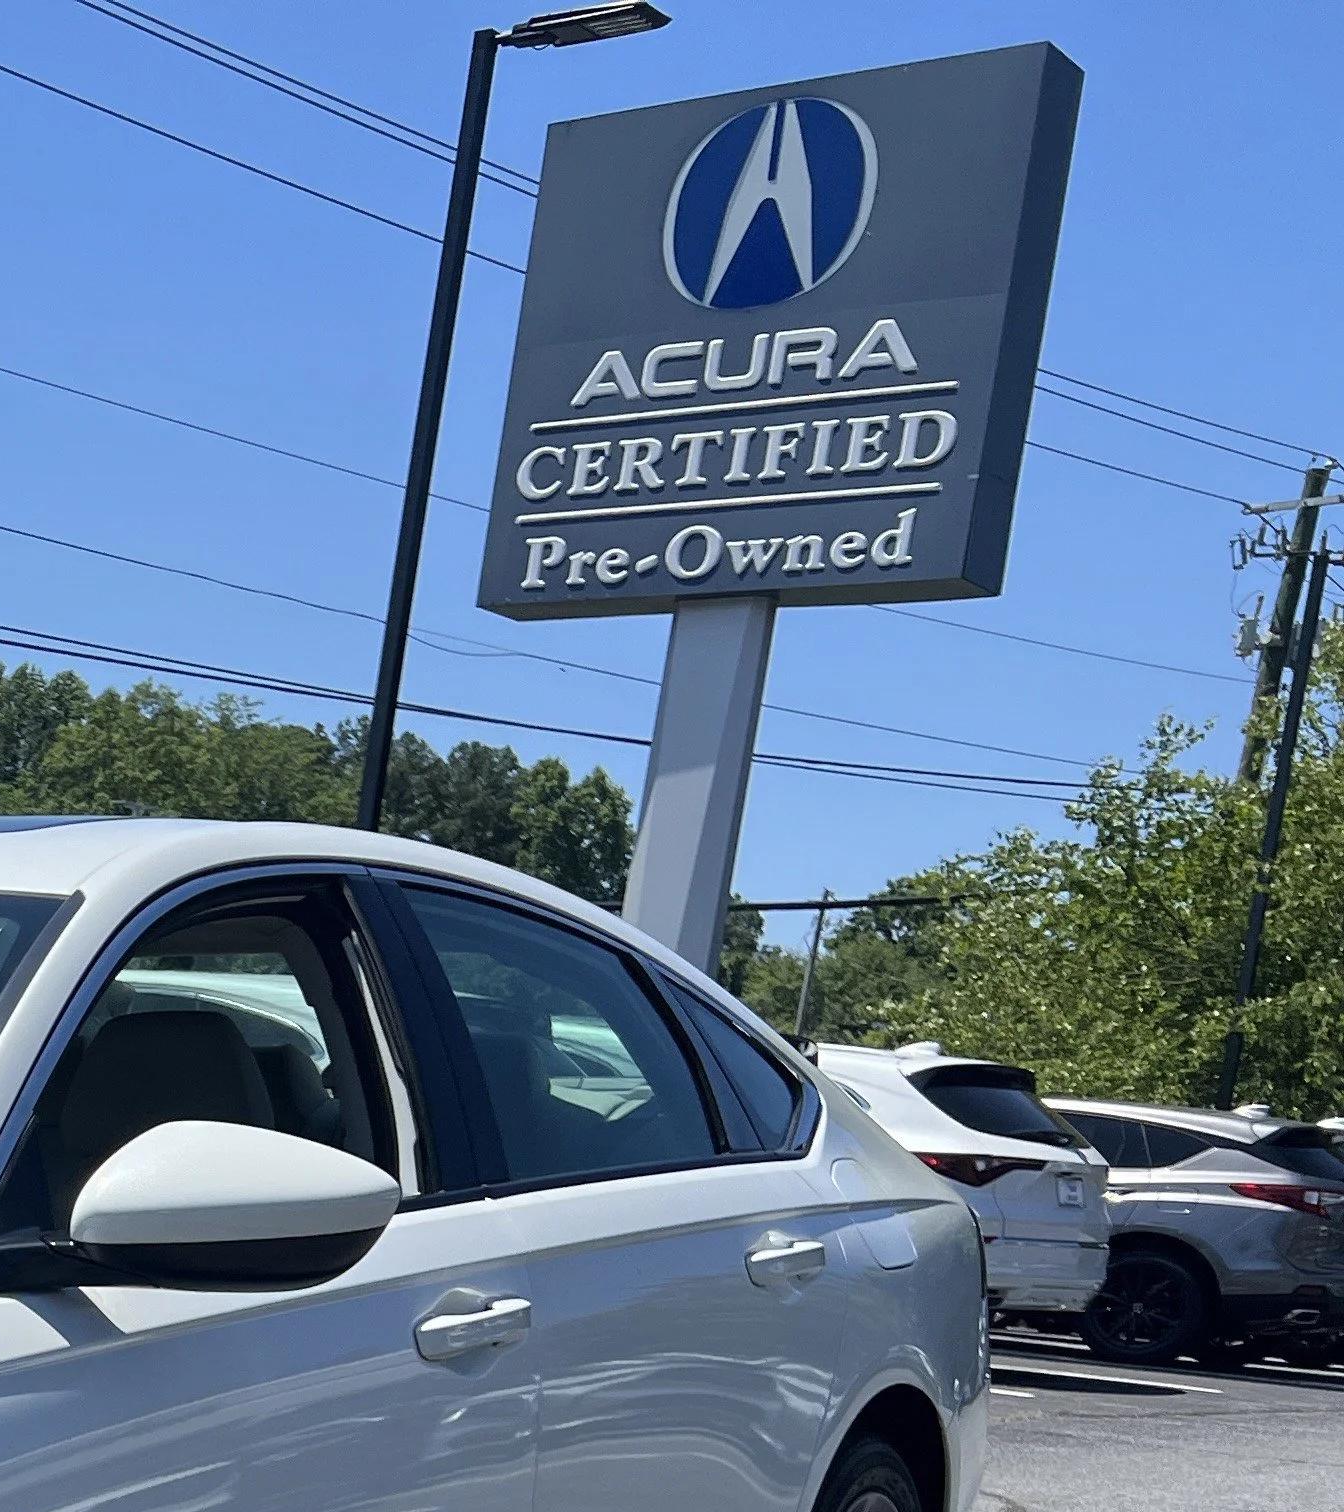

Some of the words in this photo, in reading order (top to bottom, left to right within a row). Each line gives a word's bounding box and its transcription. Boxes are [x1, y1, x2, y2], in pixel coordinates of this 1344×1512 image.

[570, 318, 919, 406] ACURA
[516, 409, 960, 500] CERTIFIED
[520, 508, 917, 590] Pre-Owned
